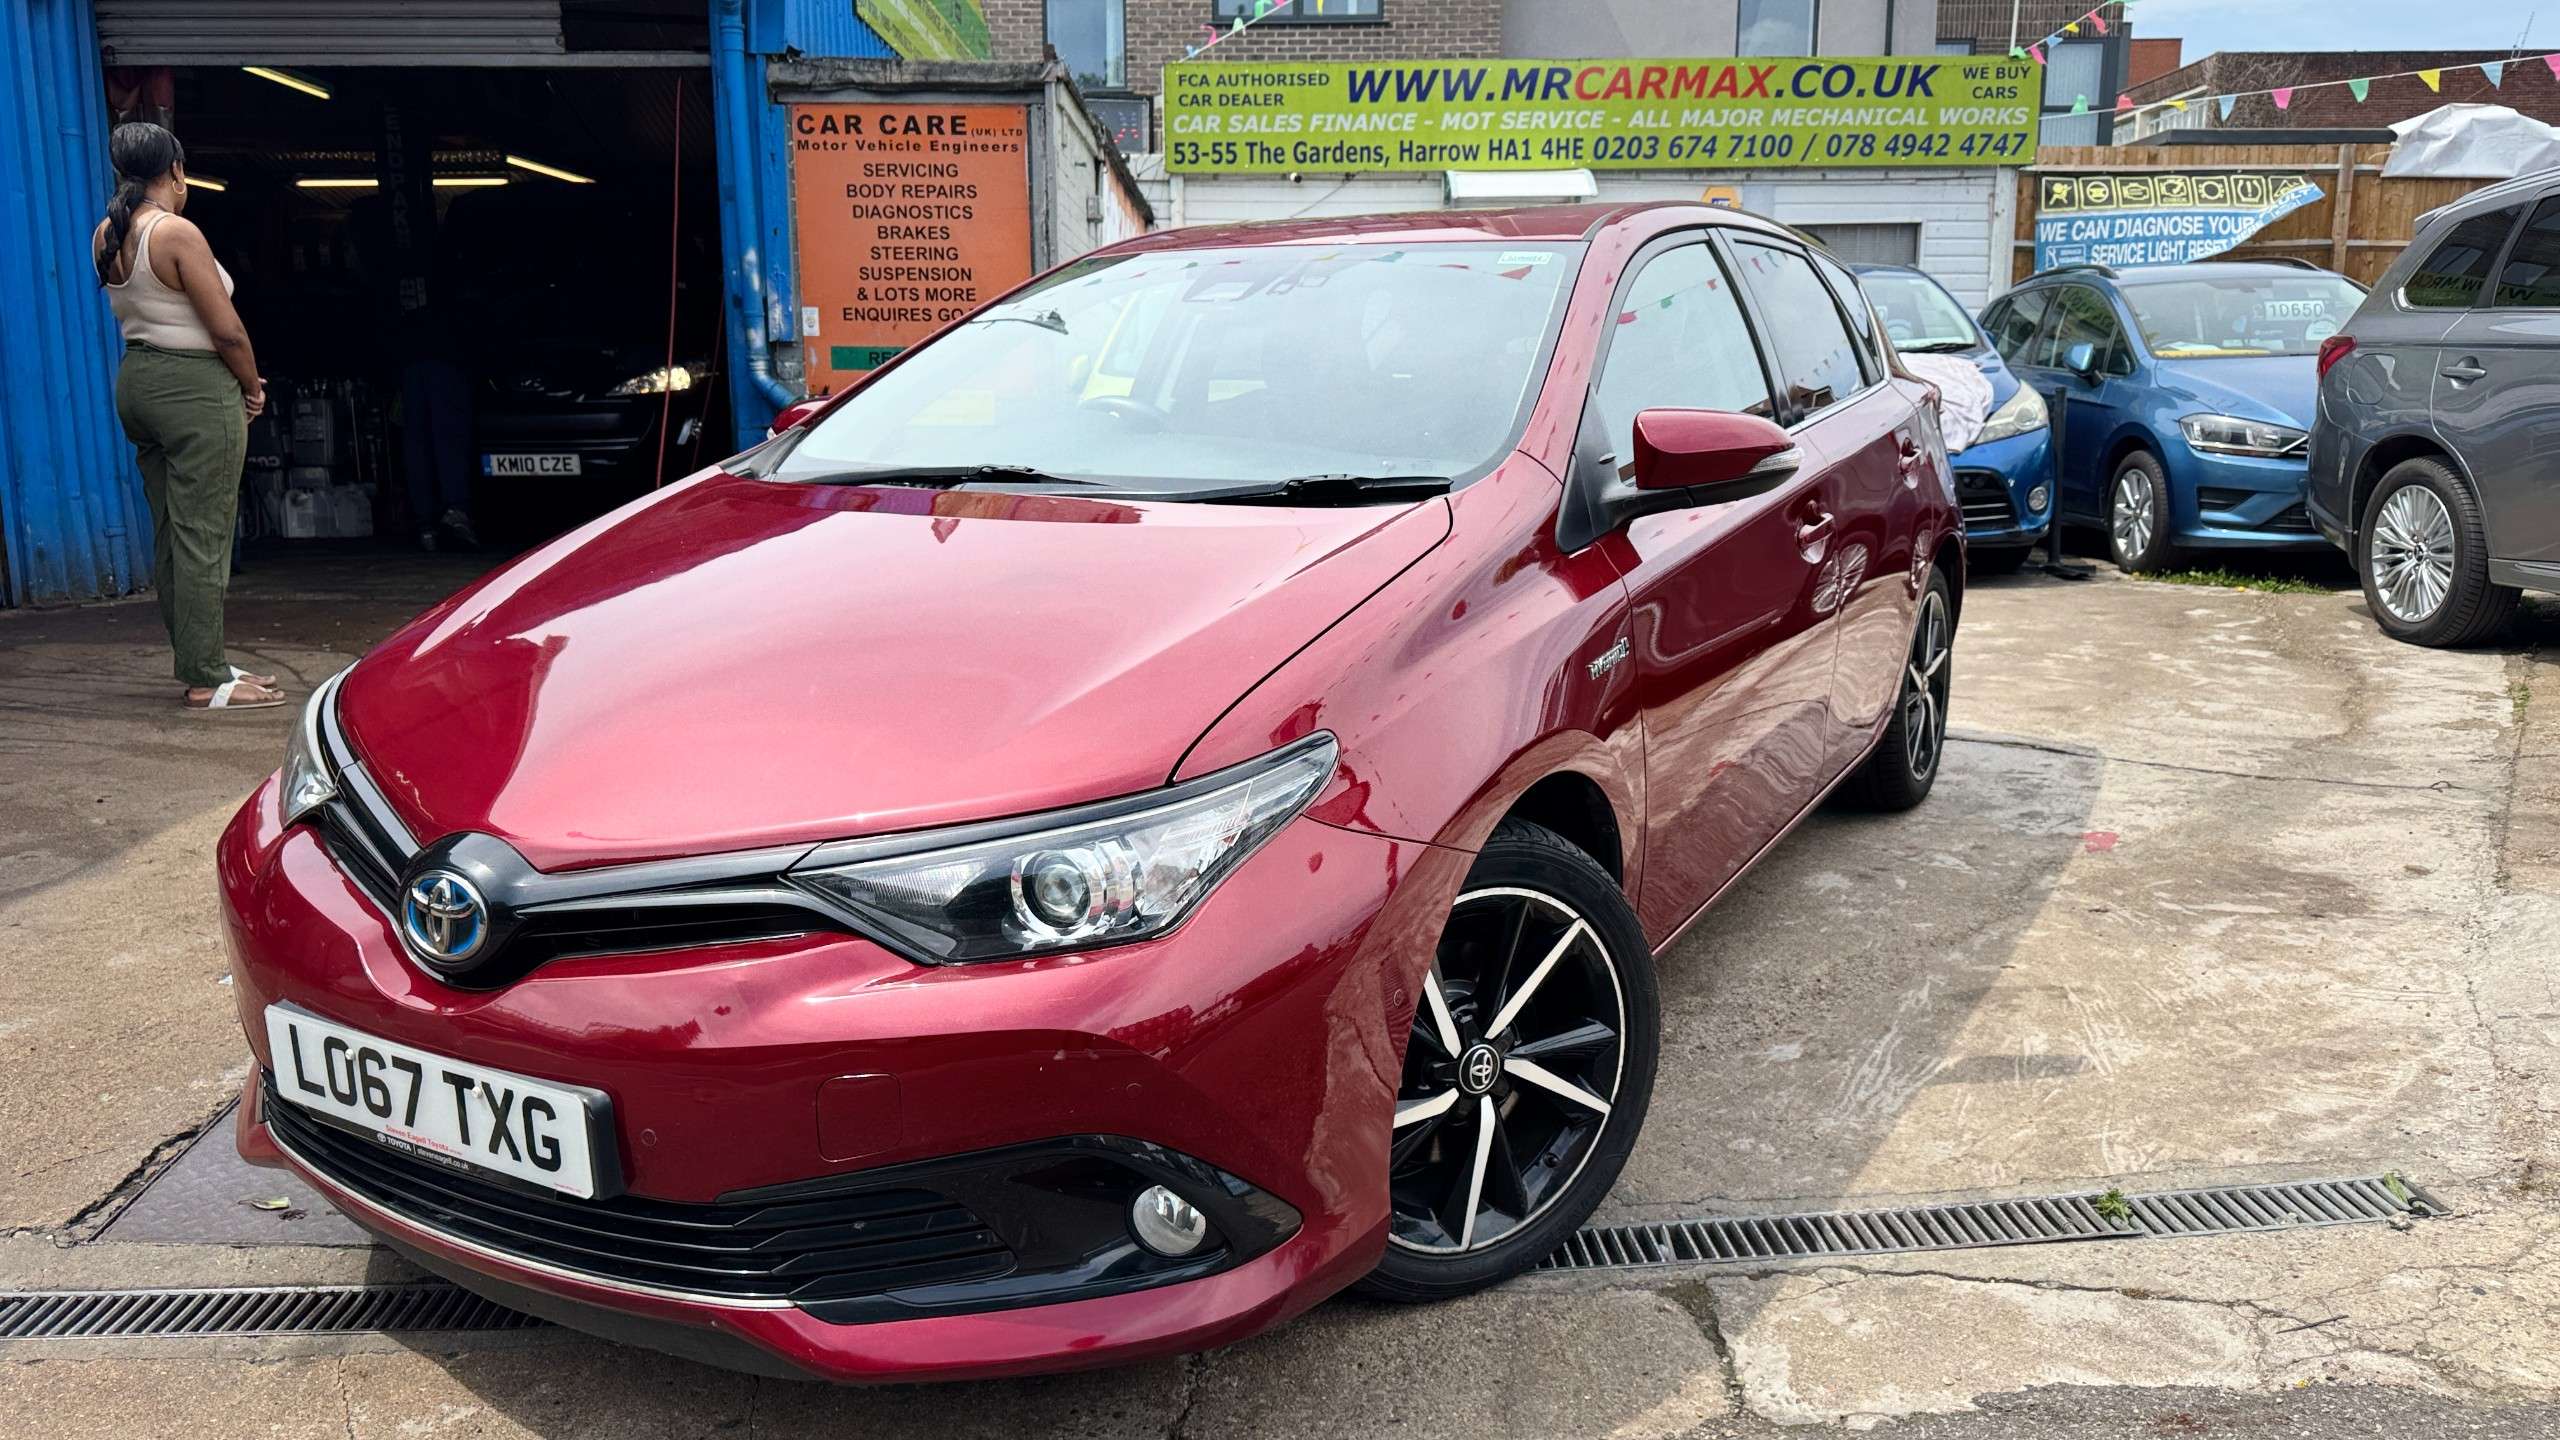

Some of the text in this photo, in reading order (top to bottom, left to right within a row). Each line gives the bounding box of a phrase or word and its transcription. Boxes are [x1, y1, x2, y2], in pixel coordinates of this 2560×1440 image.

[1178, 73, 1330, 87] FCA AUTHORISED
[1963, 66, 2032, 80] WE BUY
[1348, 64, 1941, 103] WWW.MRCARMAX.CO.UK
[1178, 93, 1284, 107] CAR DEALER
[1972, 86, 2018, 99] CARS
[797, 114, 1023, 138] CAR CARE (UK) LTD
[1173, 114, 1221, 133] CAR
[1228, 113, 1303, 133] SALES
[1309, 112, 1418, 132] FINANCE
[1440, 111, 1496, 130] MOT
[1500, 110, 1606, 130] SERVICE
[1628, 109, 1672, 128] ALL
[1680, 108, 1764, 128] MAJOR
[1771, 107, 1929, 126] MECHANICAL
[1939, 106, 2029, 126] WORKS
[797, 140, 1020, 155] Motor Vehicle Engineers
[1173, 132, 2029, 168] 53-55 The Gardens, Harrow HA1 4HE 0203 674 7100 / 078 4942 4747
[863, 163, 959, 178] SERVICING
[846, 184, 978, 199] BODY REPAIRS
[852, 205, 973, 220] DIAGNOSTICS
[877, 226, 950, 240] BRAKES
[2040, 221, 2067, 243] WE
[2072, 219, 2111, 239] CAN
[2113, 216, 2204, 239] DIAGNOSE
[870, 246, 959, 261] STEERING
[2090, 243, 2145, 265] SERVICE
[2148, 241, 2186, 262] LIGHT
[2188, 239, 2229, 258] RESET
[859, 267, 972, 281] SUSPENSION
[857, 287, 976, 302] & LOTS MORE
[843, 308, 964, 323] ENQUIRES GO
[496, 456, 574, 473] KM10 CZE
[442, 1069, 563, 1173] TXG
[387, 1136, 412, 1152] TOYOTA
